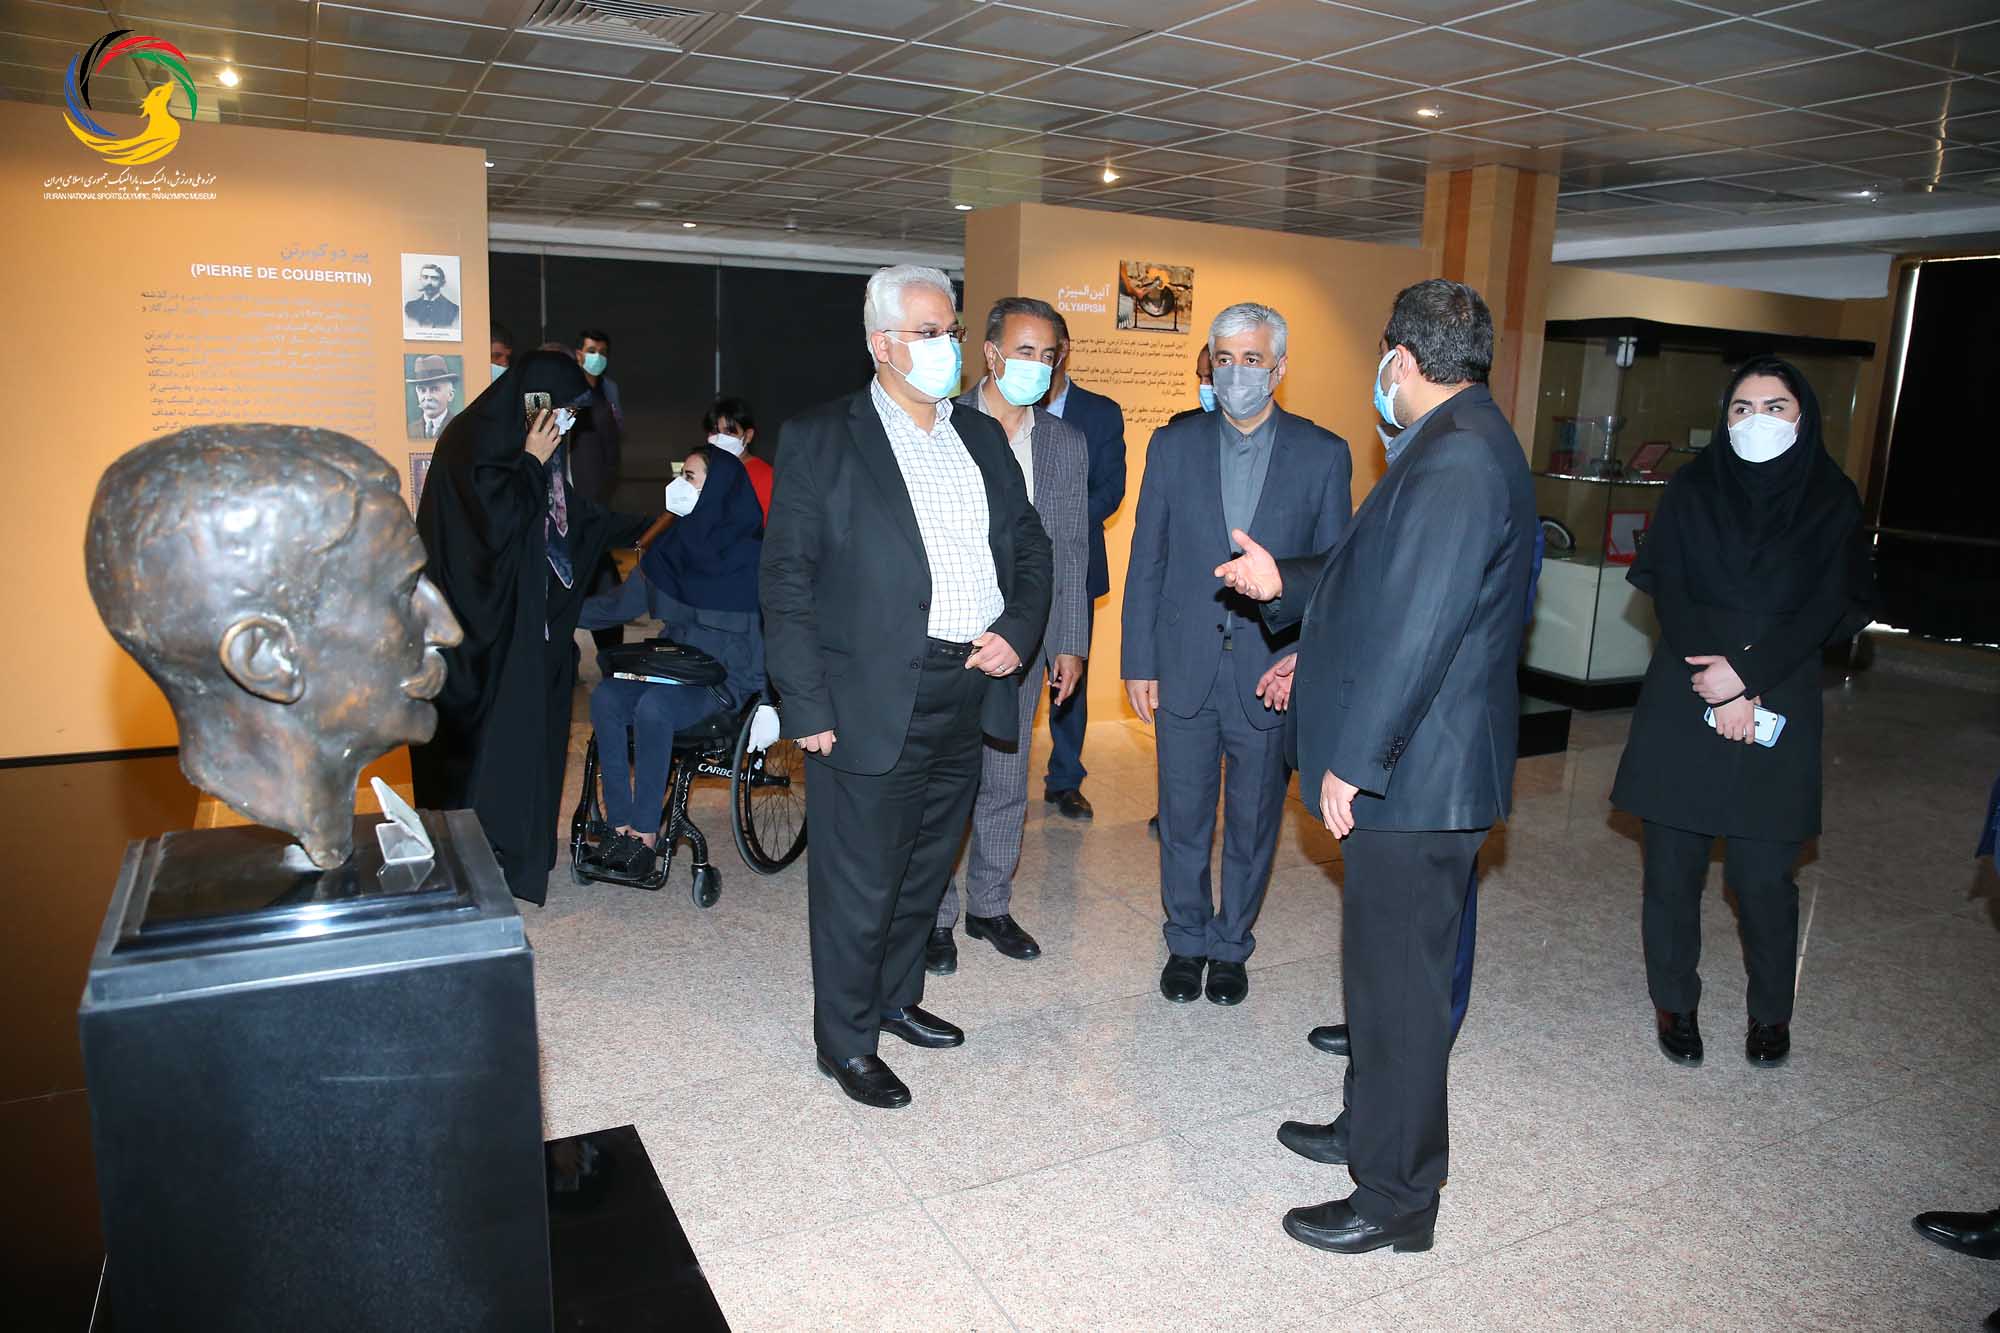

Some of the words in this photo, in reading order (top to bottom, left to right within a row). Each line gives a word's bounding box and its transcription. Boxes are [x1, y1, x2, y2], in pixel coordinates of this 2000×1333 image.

[190, 263, 254, 280] (PIERRE
[257, 266, 278, 280] DE
[281, 268, 372, 287] COUBERTIN)
[1058, 302, 1106, 312] OLYMPISM
